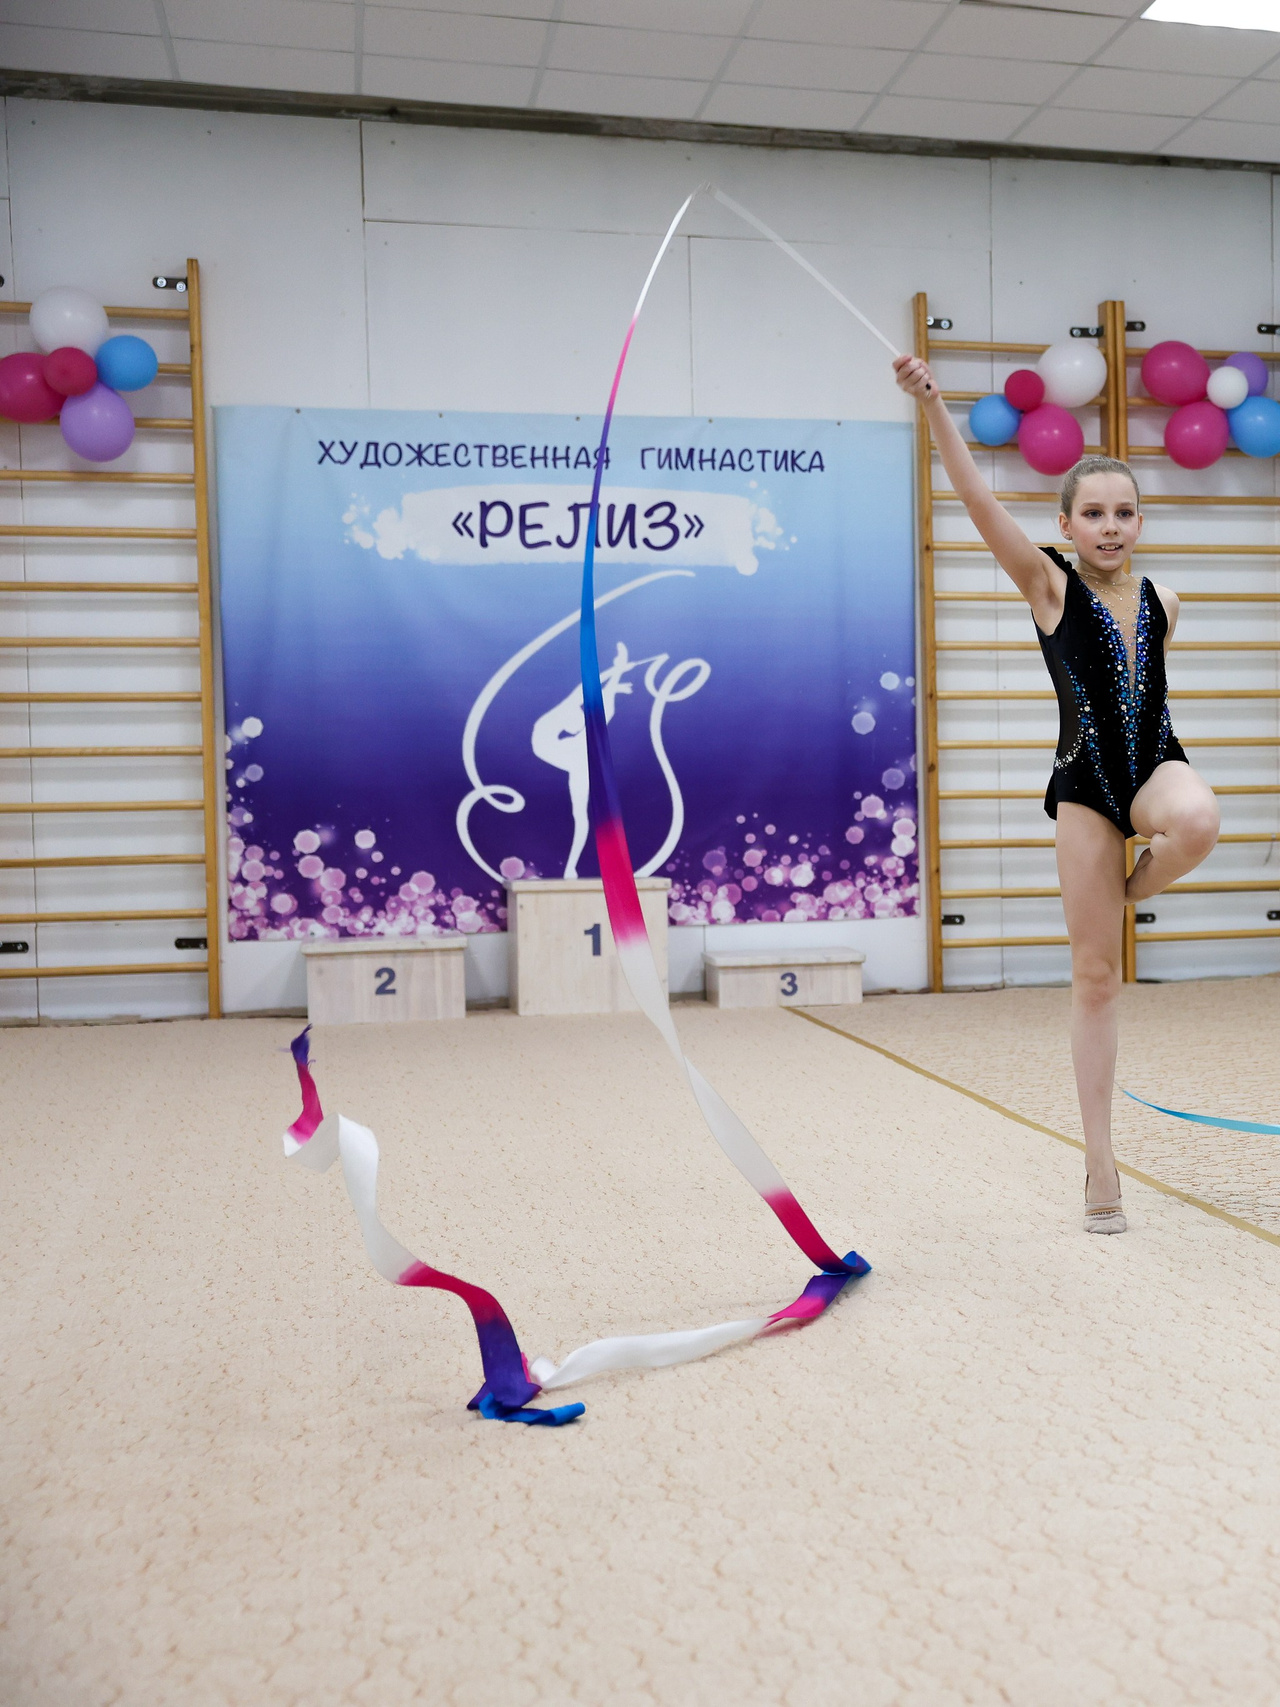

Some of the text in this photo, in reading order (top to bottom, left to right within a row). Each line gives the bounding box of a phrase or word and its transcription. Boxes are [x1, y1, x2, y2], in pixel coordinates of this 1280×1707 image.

[317, 440, 825, 473] ХУДОЖЕСТВЕННАЯ ГИМНАСТИКА
[451, 500, 705, 552] «РЕЛИЗ»
[583, 923, 602, 956] 1
[374, 967, 397, 995] 2
[780, 971, 799, 998] 3
